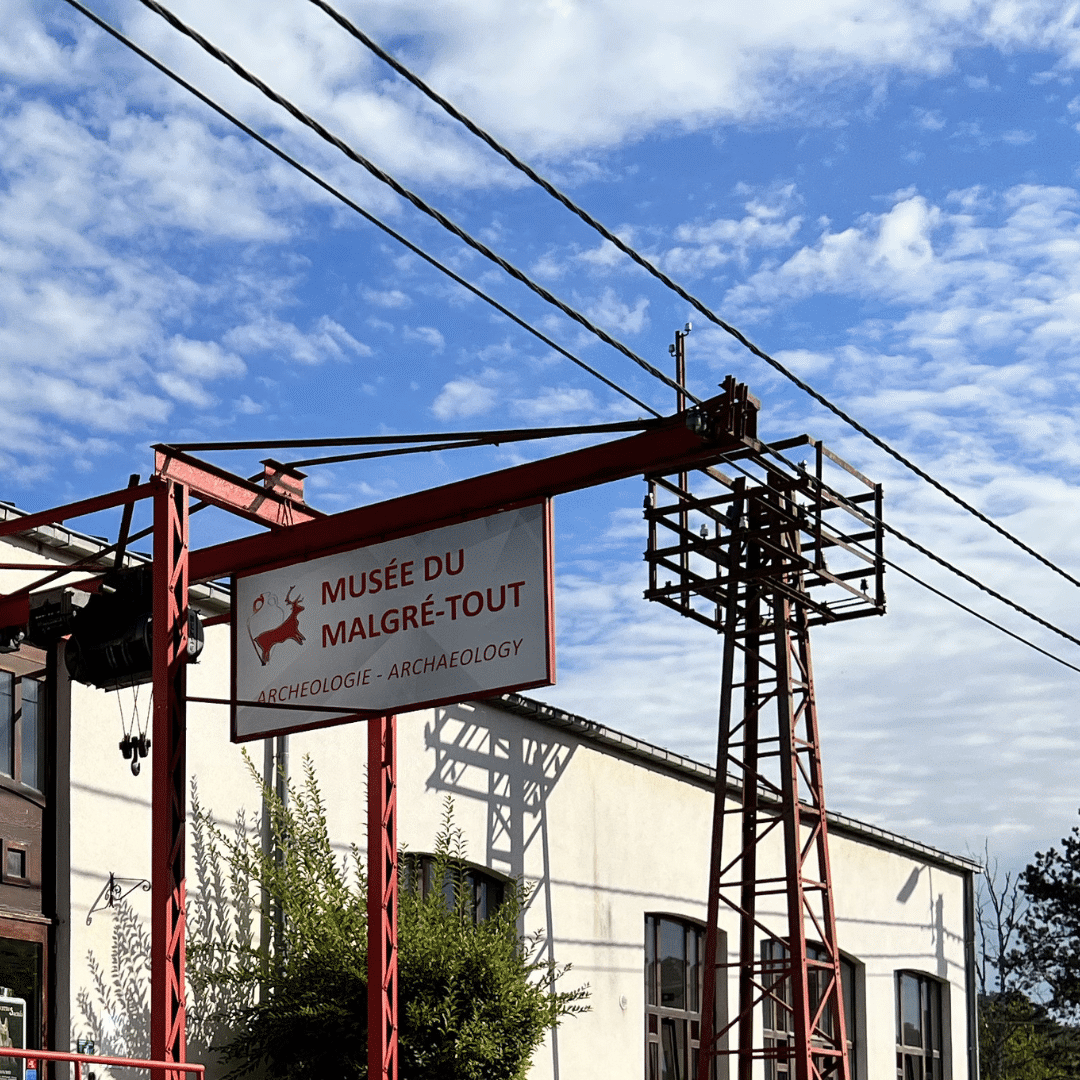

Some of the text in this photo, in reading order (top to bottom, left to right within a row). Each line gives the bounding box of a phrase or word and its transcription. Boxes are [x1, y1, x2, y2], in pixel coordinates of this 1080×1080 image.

[321, 549, 465, 605] MUSÉE DU
[321, 581, 526, 648] MALGRÉ-TOUT
[257, 668, 373, 704] ARCHEOLOGIE
[387, 638, 524, 681] ARCHAEOLOGY
